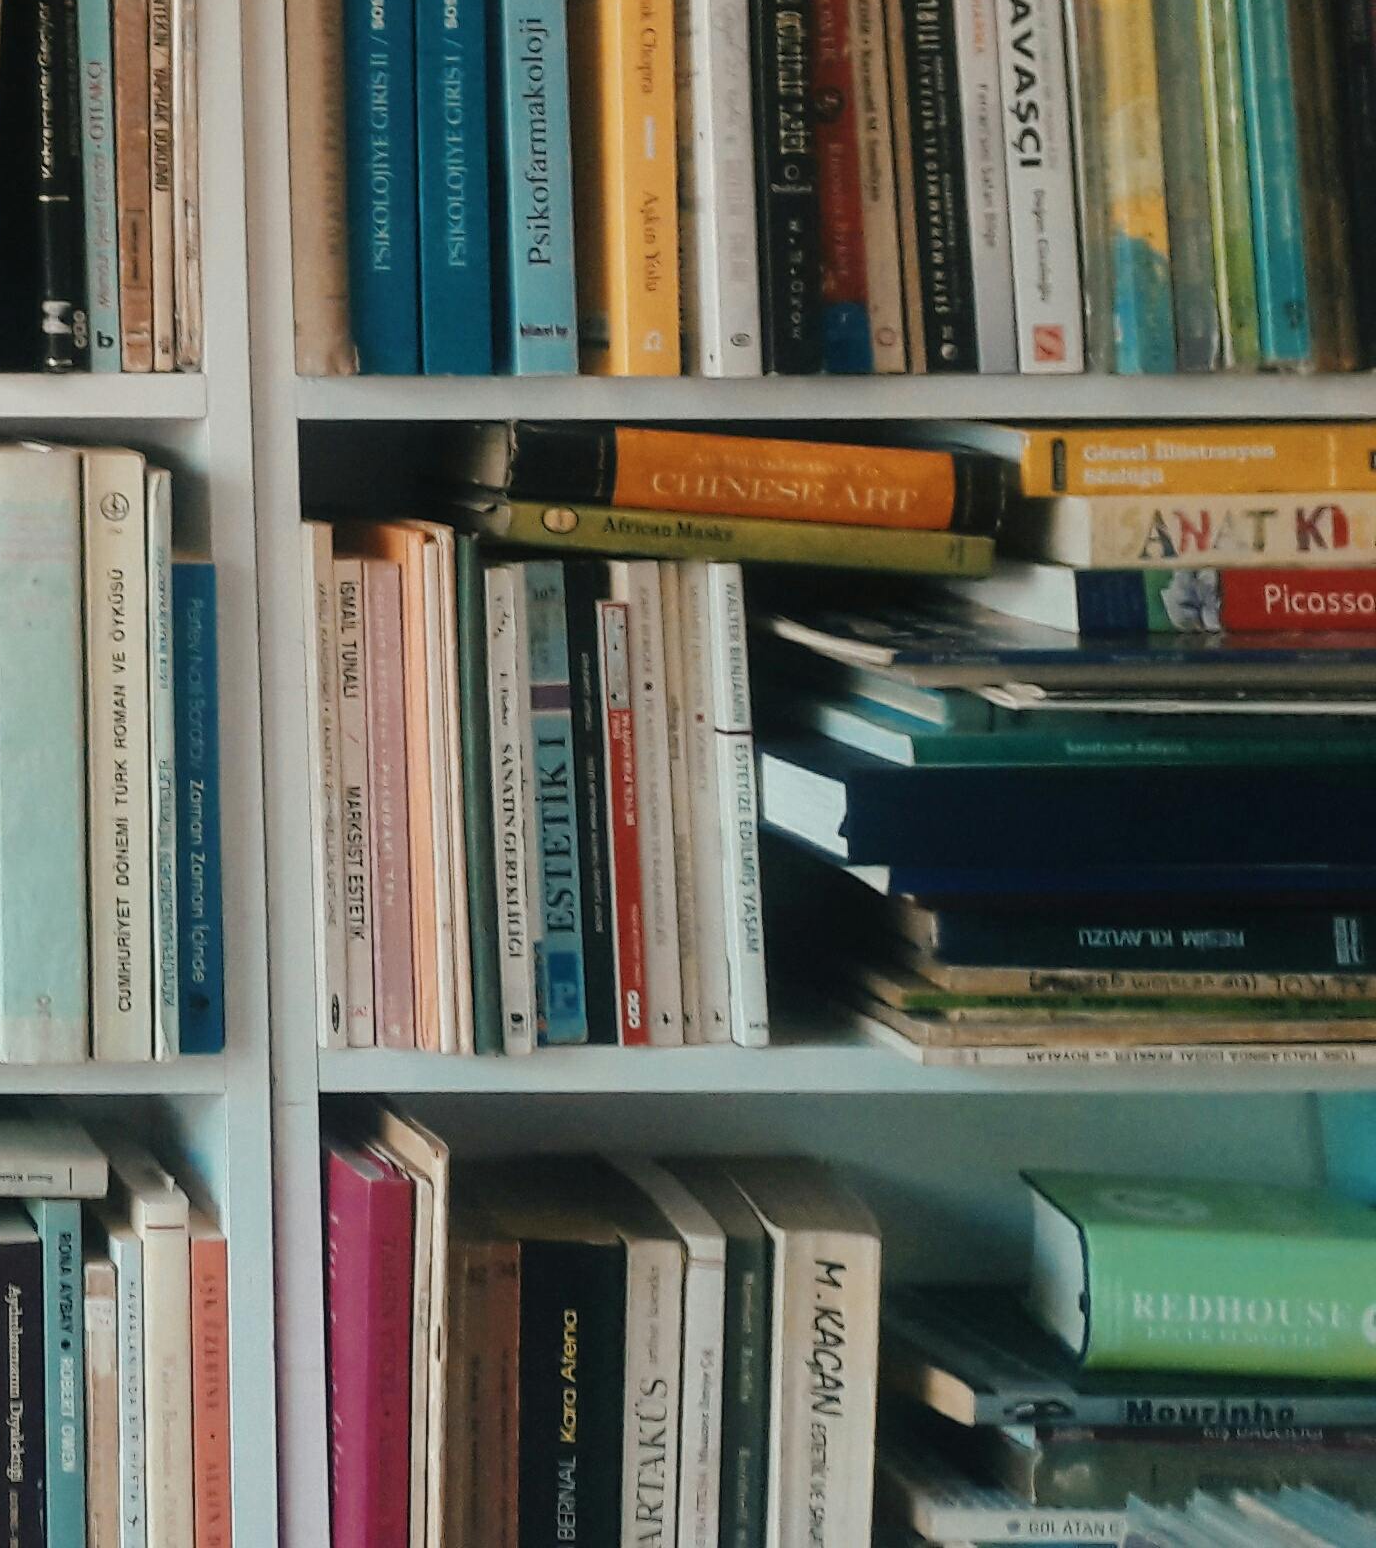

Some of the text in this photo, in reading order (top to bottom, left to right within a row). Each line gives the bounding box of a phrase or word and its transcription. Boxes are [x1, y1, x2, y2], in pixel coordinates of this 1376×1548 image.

[520, 17, 553, 266] Psikofarmakoloji
[110, 650, 127, 674] VE
[110, 684, 128, 750] ROMAN
[111, 758, 129, 806] TÜRK
[114, 896, 135, 1013] CUMHURİYET
